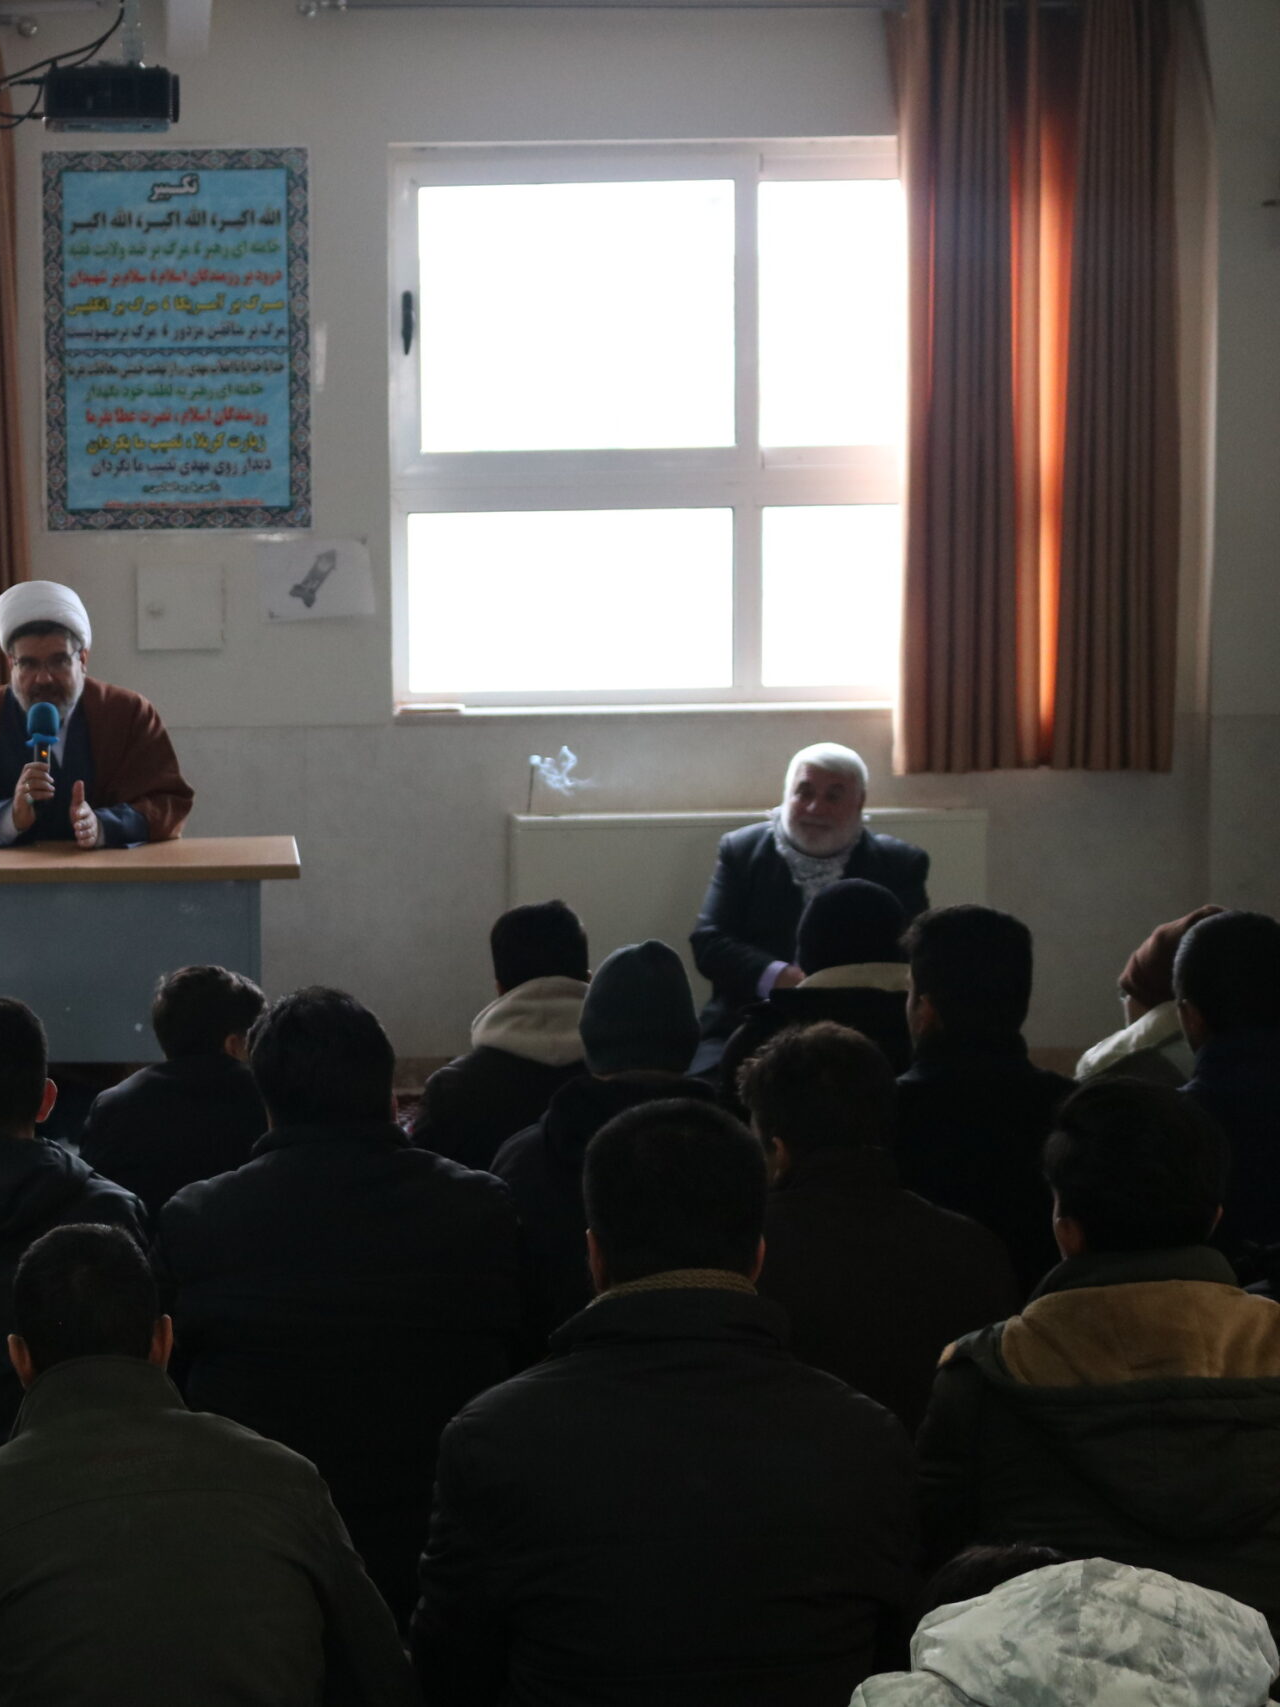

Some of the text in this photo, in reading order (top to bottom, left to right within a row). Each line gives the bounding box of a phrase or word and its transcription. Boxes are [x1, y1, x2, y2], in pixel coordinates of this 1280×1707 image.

[147, 173, 199, 202] تکبیر
[70, 211, 106, 235] اکبر
[111, 207, 132, 228] الله
[184, 206, 207, 227] الله
[259, 205, 281, 226] الله
[112, 301, 126, 316] بر
[127, 296, 159, 316] مرگ
[227, 298, 242, 316] بر
[243, 294, 285, 315] مرگ
